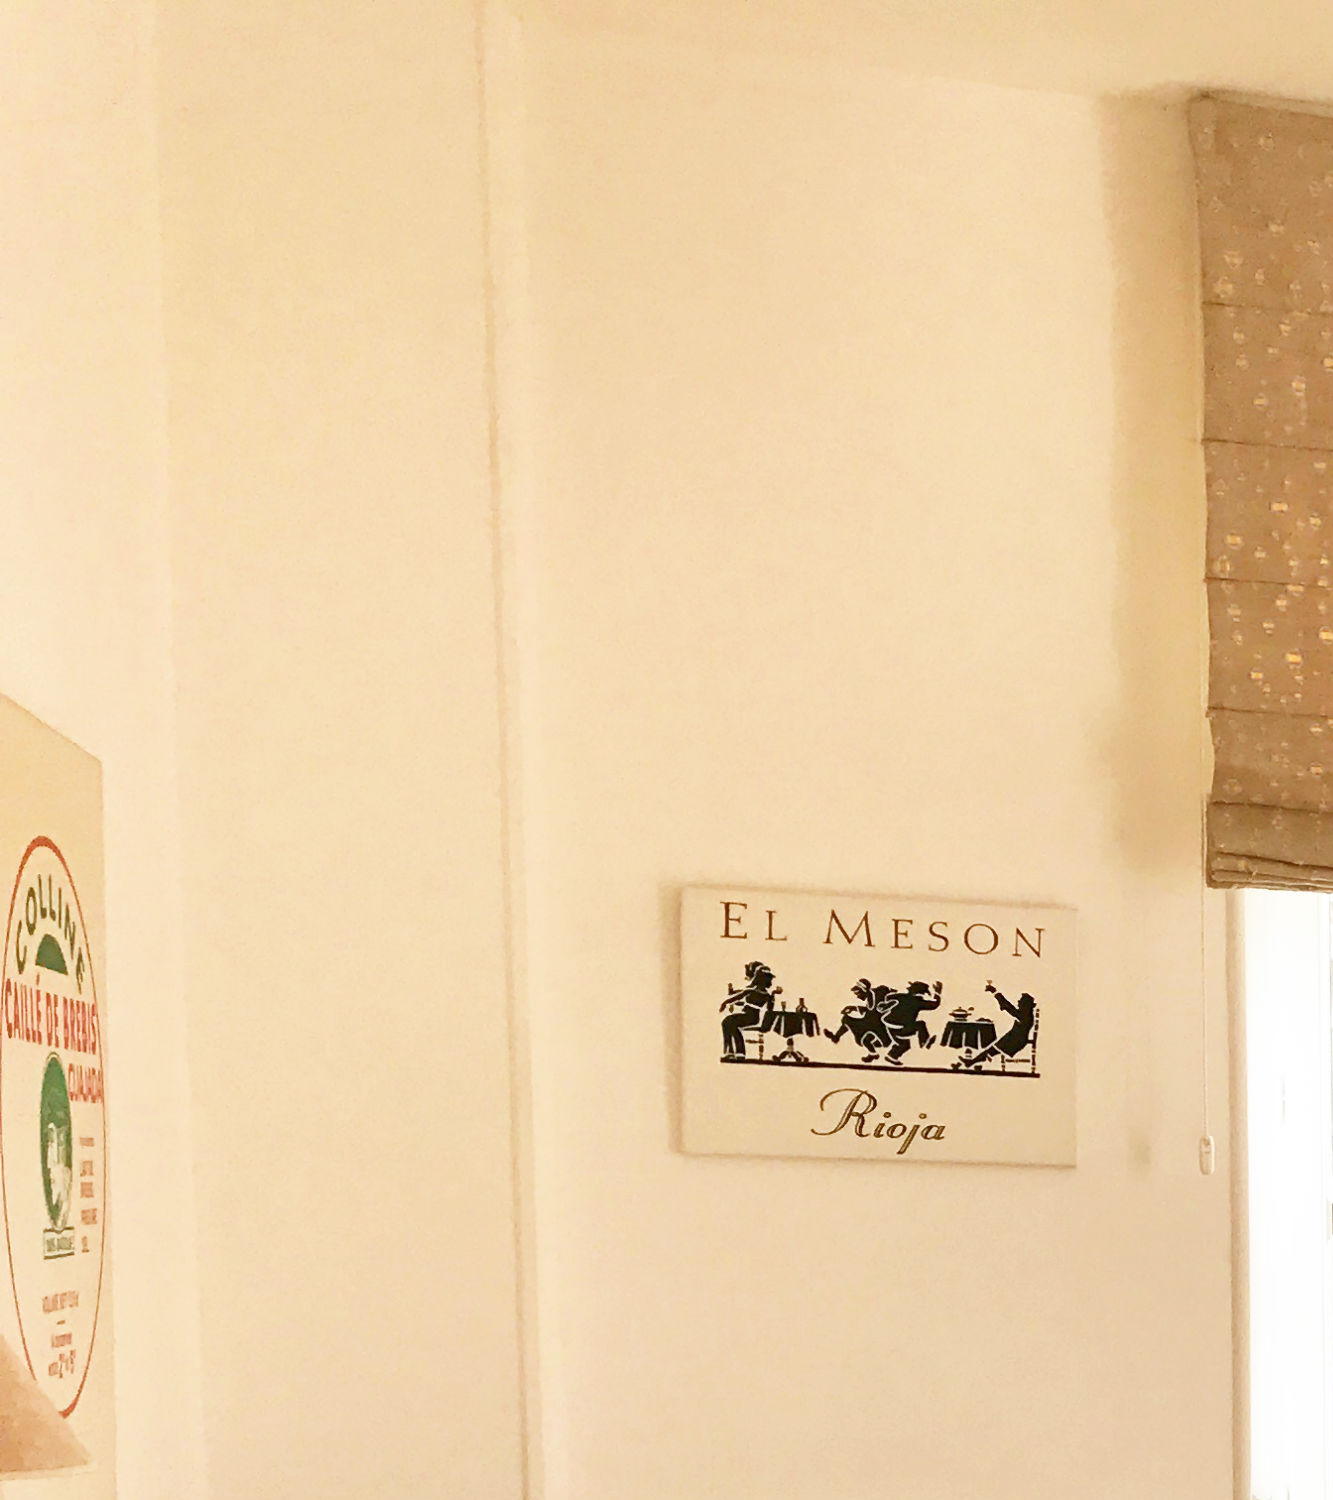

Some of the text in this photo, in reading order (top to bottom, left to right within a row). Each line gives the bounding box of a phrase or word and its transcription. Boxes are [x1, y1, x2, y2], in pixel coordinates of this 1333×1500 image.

[16, 873, 85, 995] COLLINE
[719, 901, 1047, 959] EL MESON
[5, 972, 97, 1055] CAILLÉ DE BREBIS
[810, 1088, 947, 1156] Rioja
